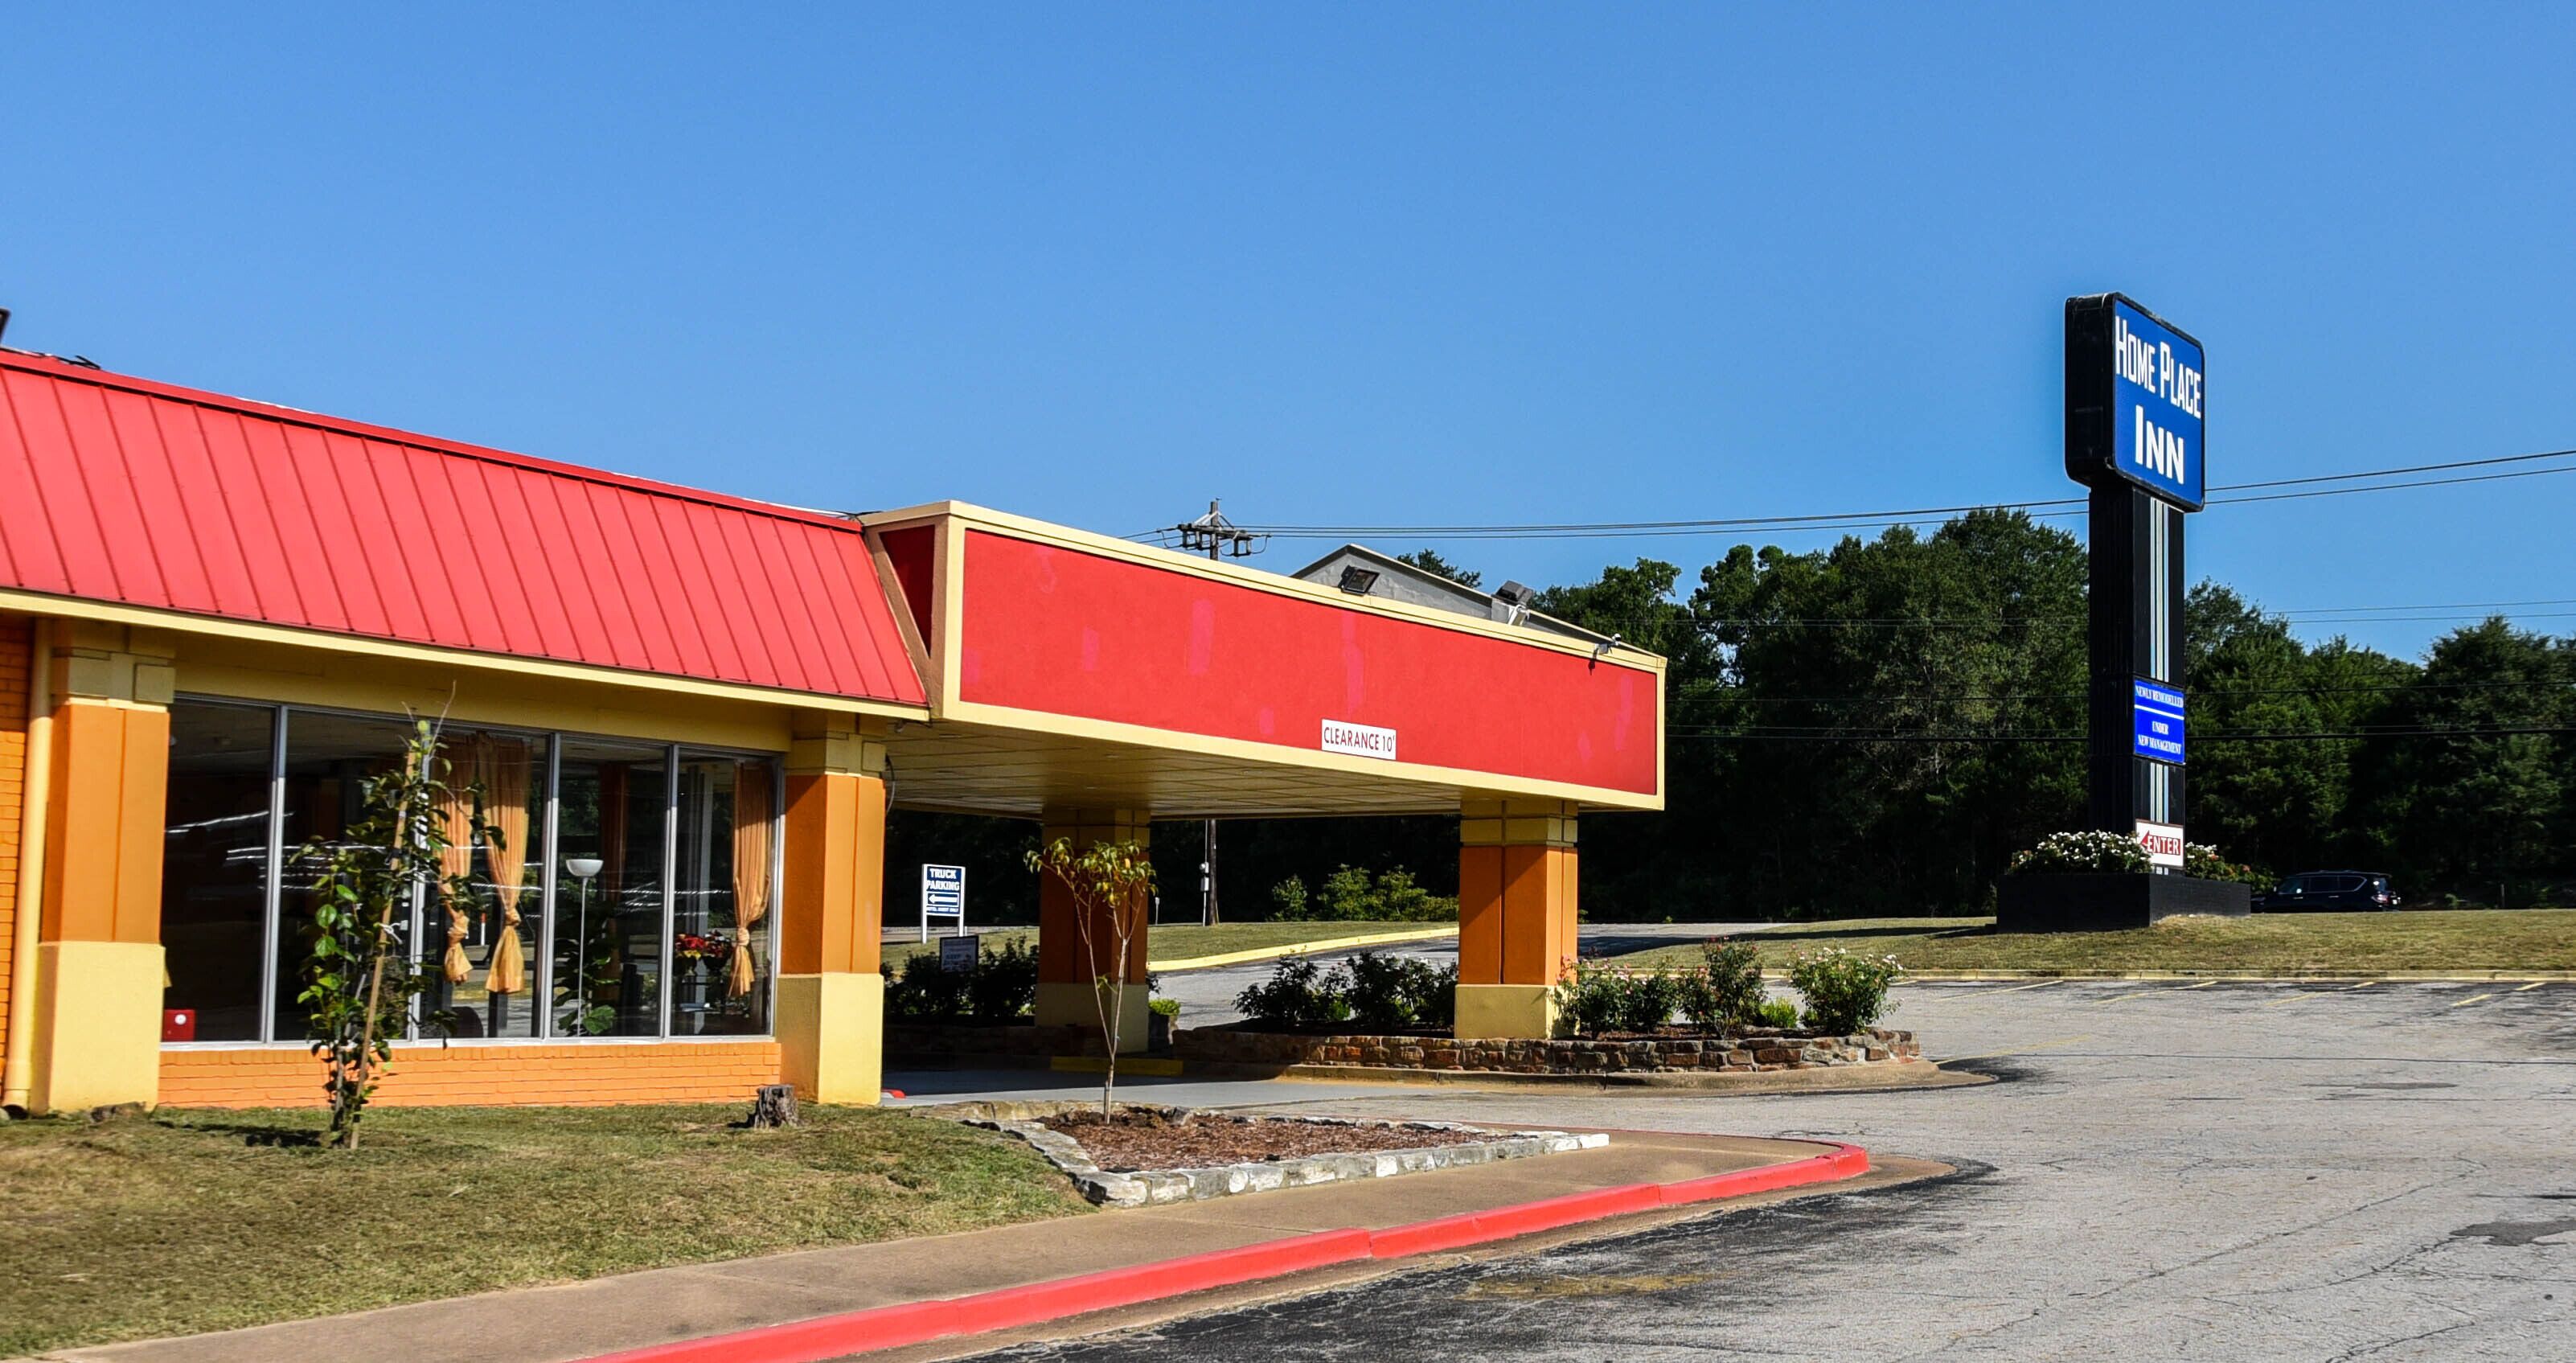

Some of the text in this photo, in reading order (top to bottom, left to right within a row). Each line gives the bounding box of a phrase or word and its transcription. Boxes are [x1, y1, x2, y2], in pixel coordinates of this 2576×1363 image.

[2115, 315, 2201, 419] HOME PLACE
[2135, 404, 2184, 485] INN
[1323, 726, 1379, 751] CLEARANCE
[2147, 835, 2180, 855] ENTER
[929, 868, 957, 880] TRUCK
[926, 880, 960, 891] PARKING
